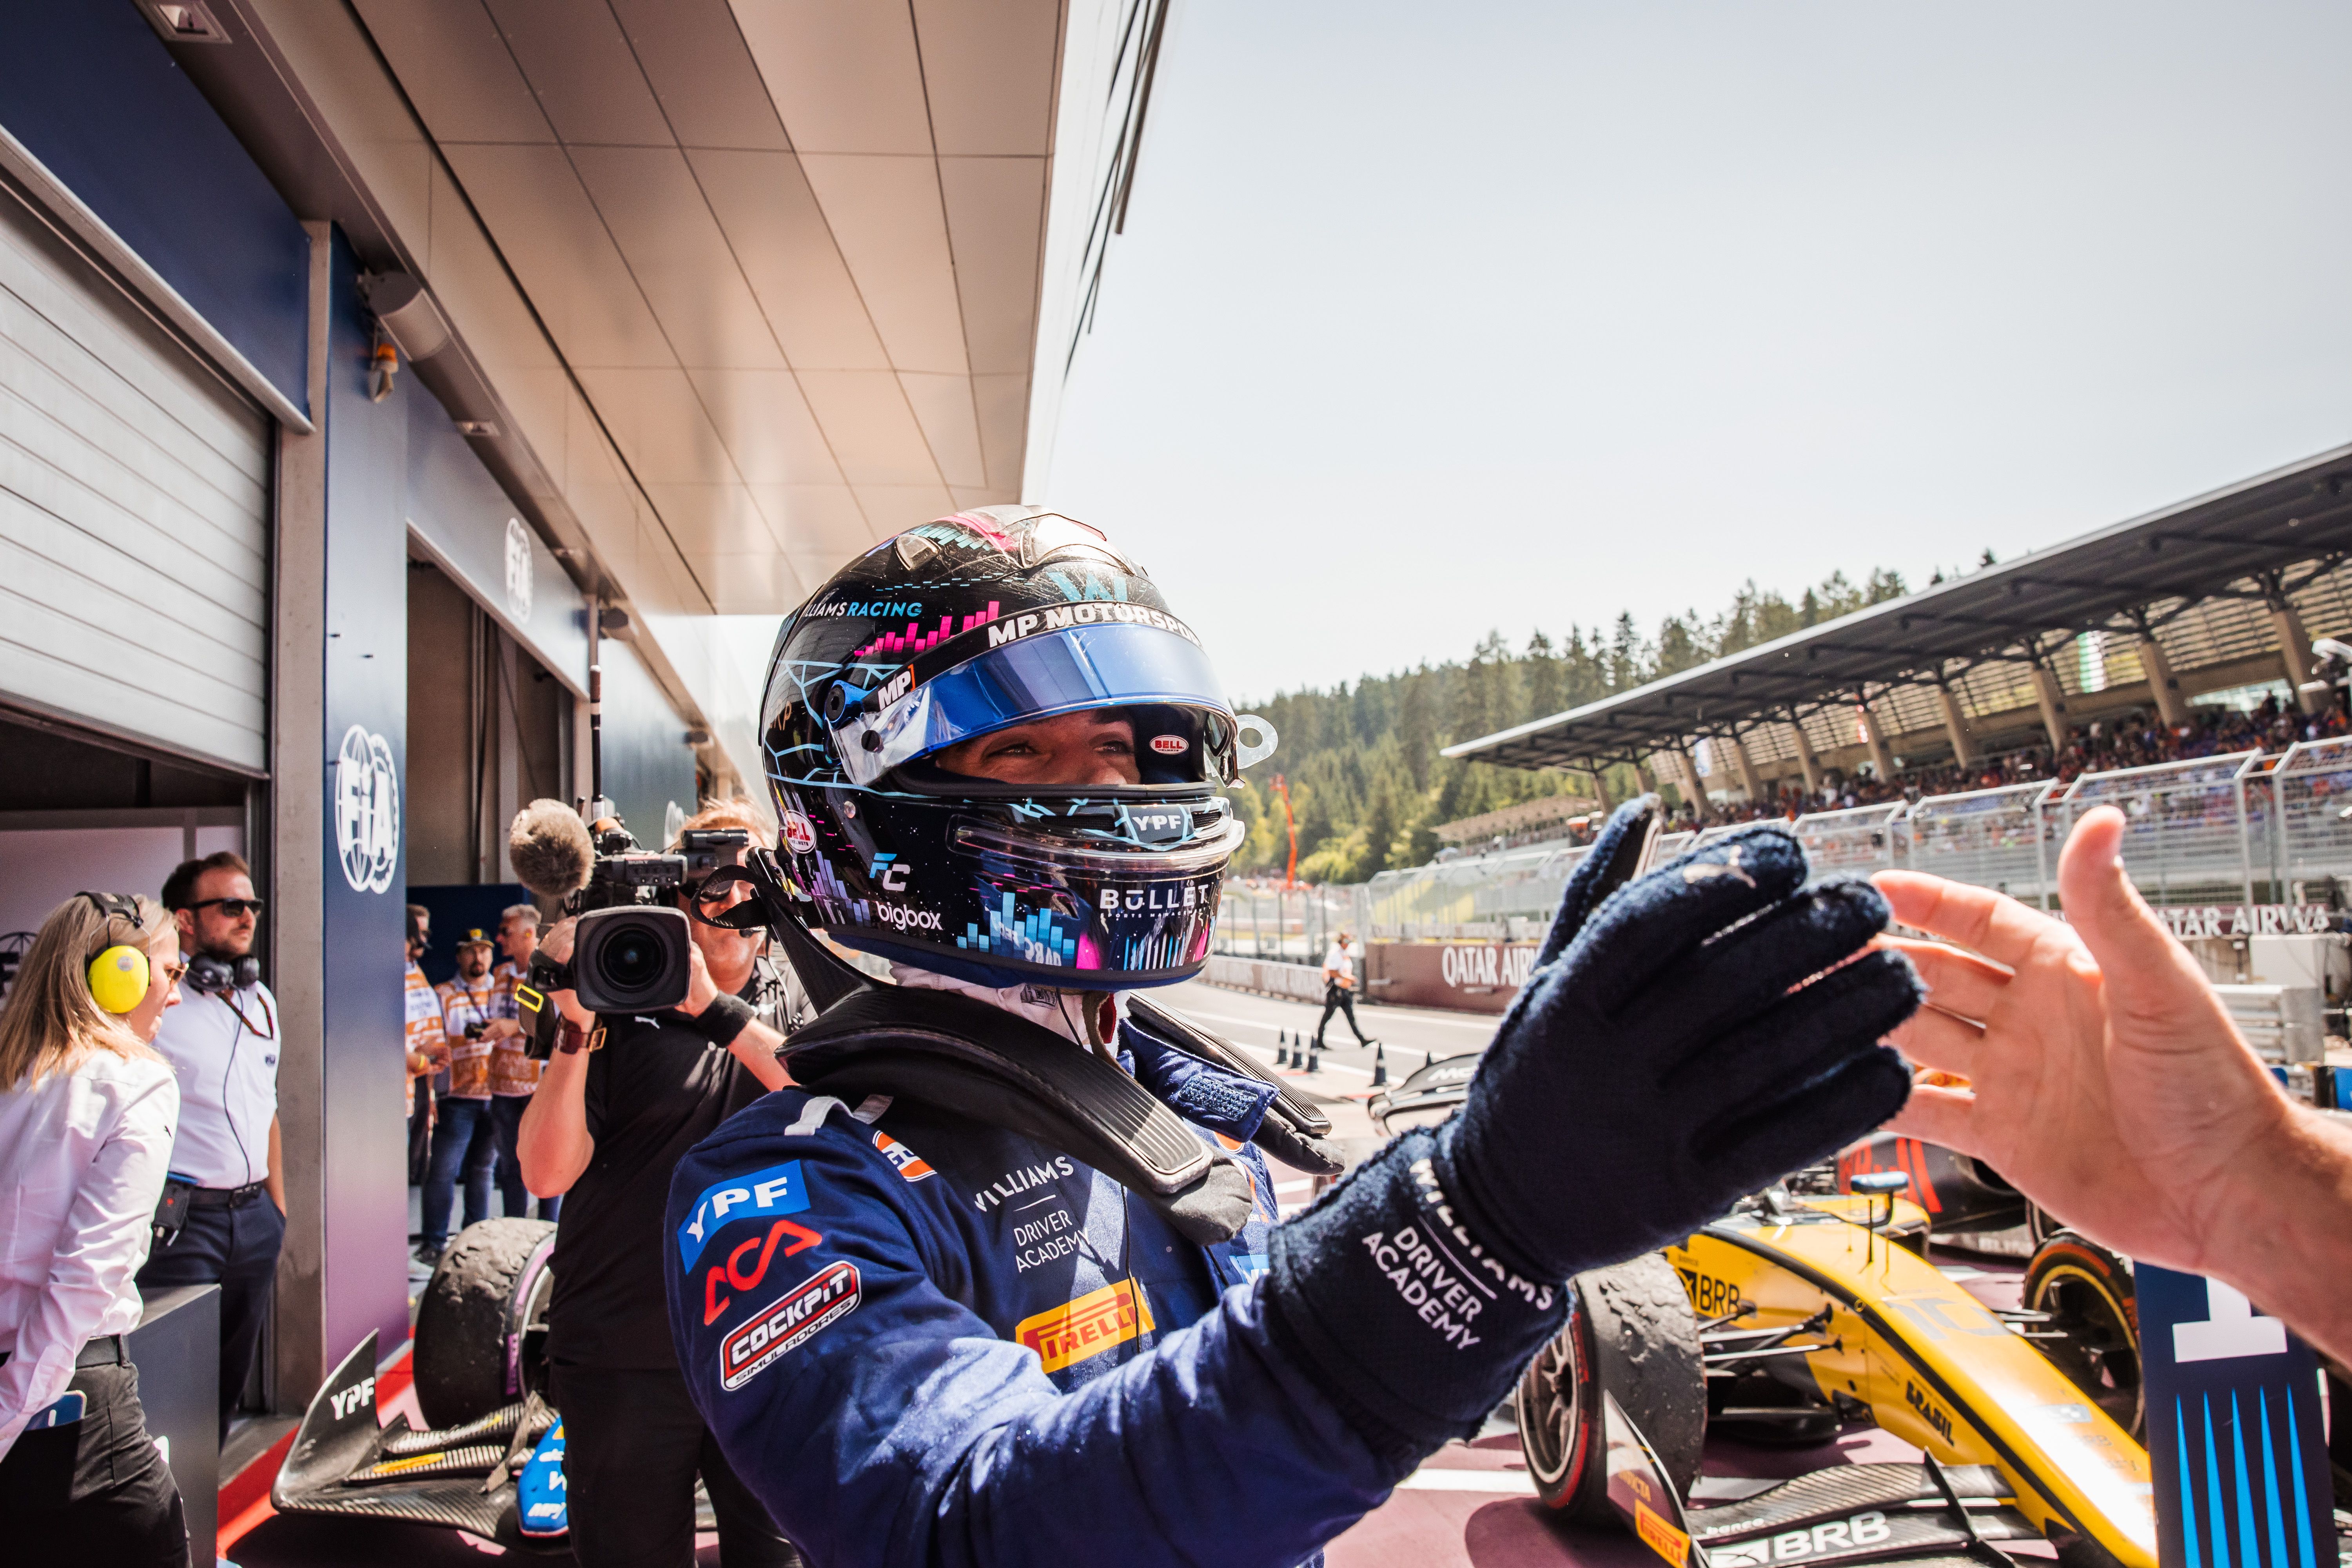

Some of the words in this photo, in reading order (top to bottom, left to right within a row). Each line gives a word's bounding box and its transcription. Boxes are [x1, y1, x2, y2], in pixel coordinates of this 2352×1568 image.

[802, 602, 847, 617] LLIAMS
[847, 602, 922, 617] RACING
[988, 614, 1037, 648] MP
[1045, 603, 1203, 651] MOTORSPOR
[1154, 740, 1184, 749] BELL
[1132, 815, 1181, 831] YPF
[875, 901, 944, 931] bigbox
[1442, 947, 1499, 987] QATAR
[687, 1176, 788, 1243] YPF
[1014, 1210, 1073, 1247] DRIVER
[1016, 1227, 1090, 1273] ACADEMY
[1362, 1231, 1481, 1349] ACADEMY
[1394, 1227, 1483, 1322] DRIVER
[1700, 1274, 1739, 1316] BRB
[1023, 1293, 1136, 1362] PIRELLI
[330, 1376, 375, 1420] YPF
[1906, 1379, 1955, 1446] BRASIL
[1706, 1517, 1764, 1535] banco
[1774, 1511, 1891, 1560] BRB
